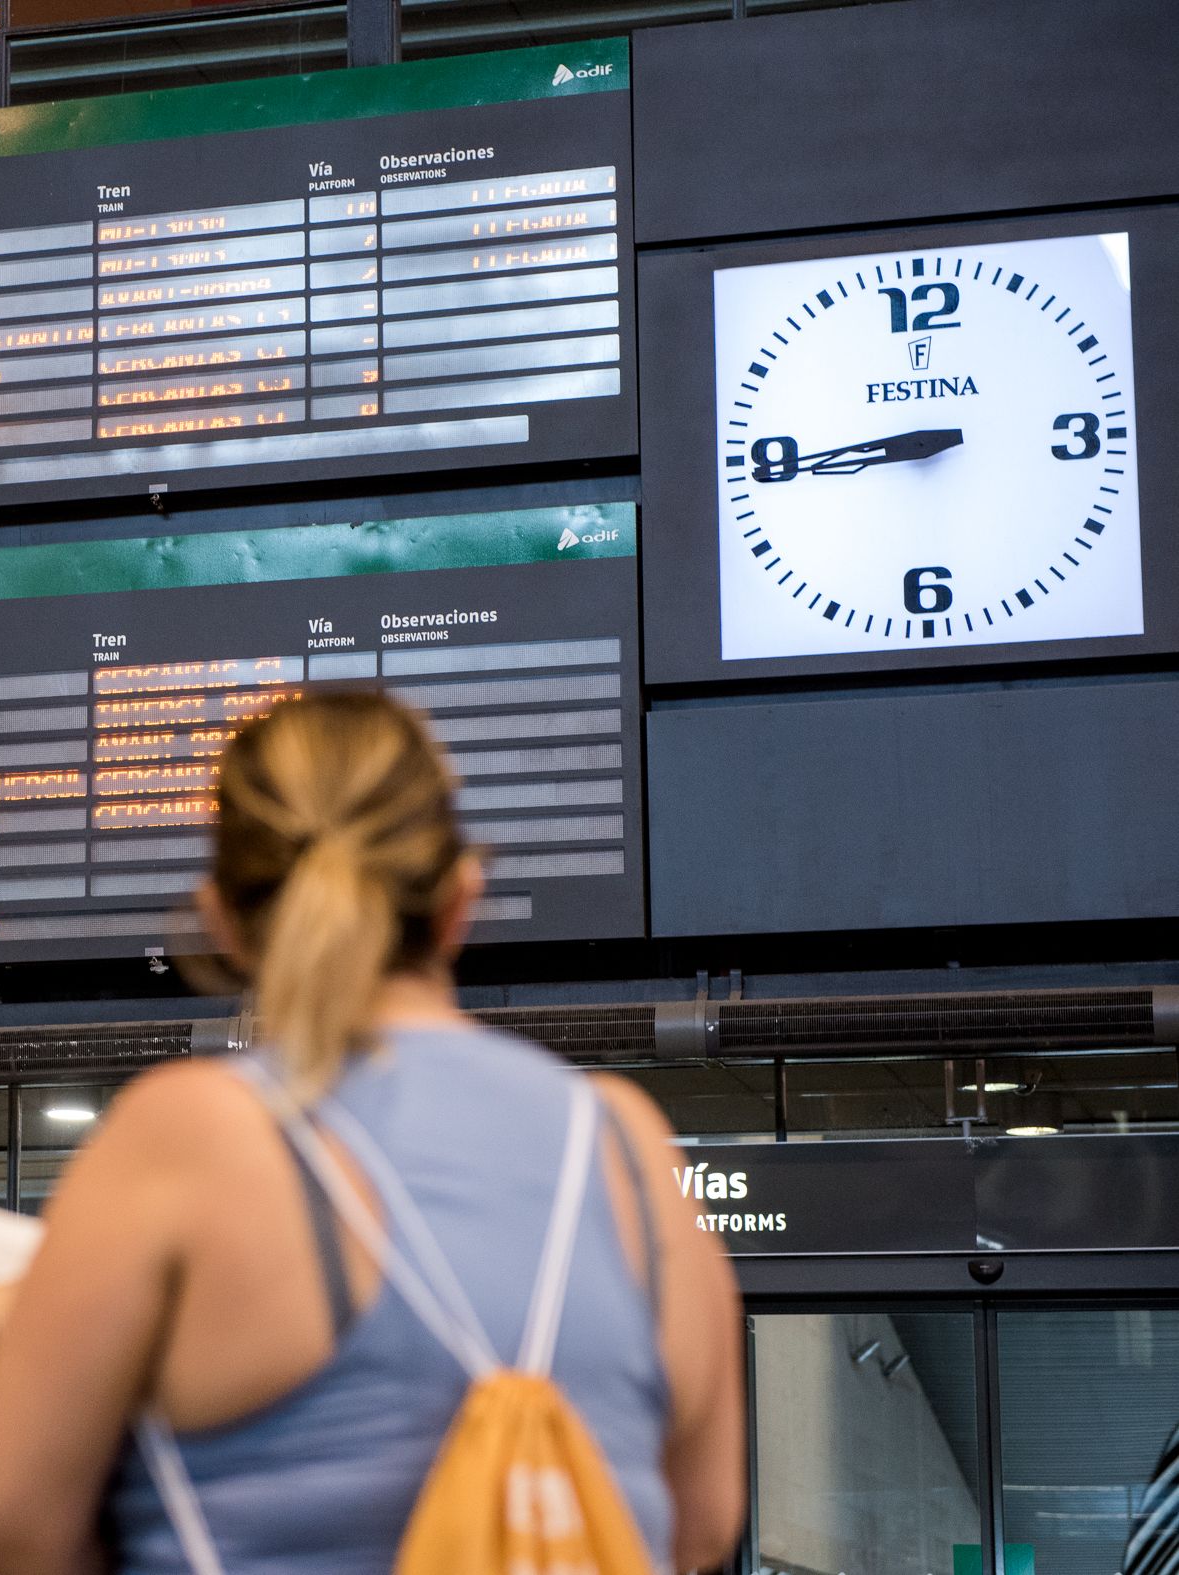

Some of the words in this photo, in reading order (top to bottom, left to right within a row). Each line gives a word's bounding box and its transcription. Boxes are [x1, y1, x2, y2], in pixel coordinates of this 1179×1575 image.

[576, 63, 614, 79] adif
[379, 146, 495, 170] Observaciones
[309, 161, 333, 177] Vía
[380, 168, 447, 184] OBSERVATIONS
[97, 184, 131, 199] Tren
[309, 178, 355, 191] PLATFORM
[97, 202, 124, 213] TRAIN
[878, 282, 961, 334] 12
[866, 376, 979, 403] FESTINA
[1050, 412, 1101, 460] 3
[751, 435, 798, 483] 9
[581, 529, 619, 544] adif
[903, 566, 953, 614] 6
[308, 617, 333, 634] Vía
[380, 608, 498, 629] Observaciones
[92, 632, 126, 648] Tren
[307, 636, 355, 649] PLATFORM
[380, 630, 449, 644] OBSERVATIONS
[92, 652, 120, 662] TRAIN
[672, 1162, 748, 1200] Vías
[695, 1213, 787, 1232] ATFORMS
